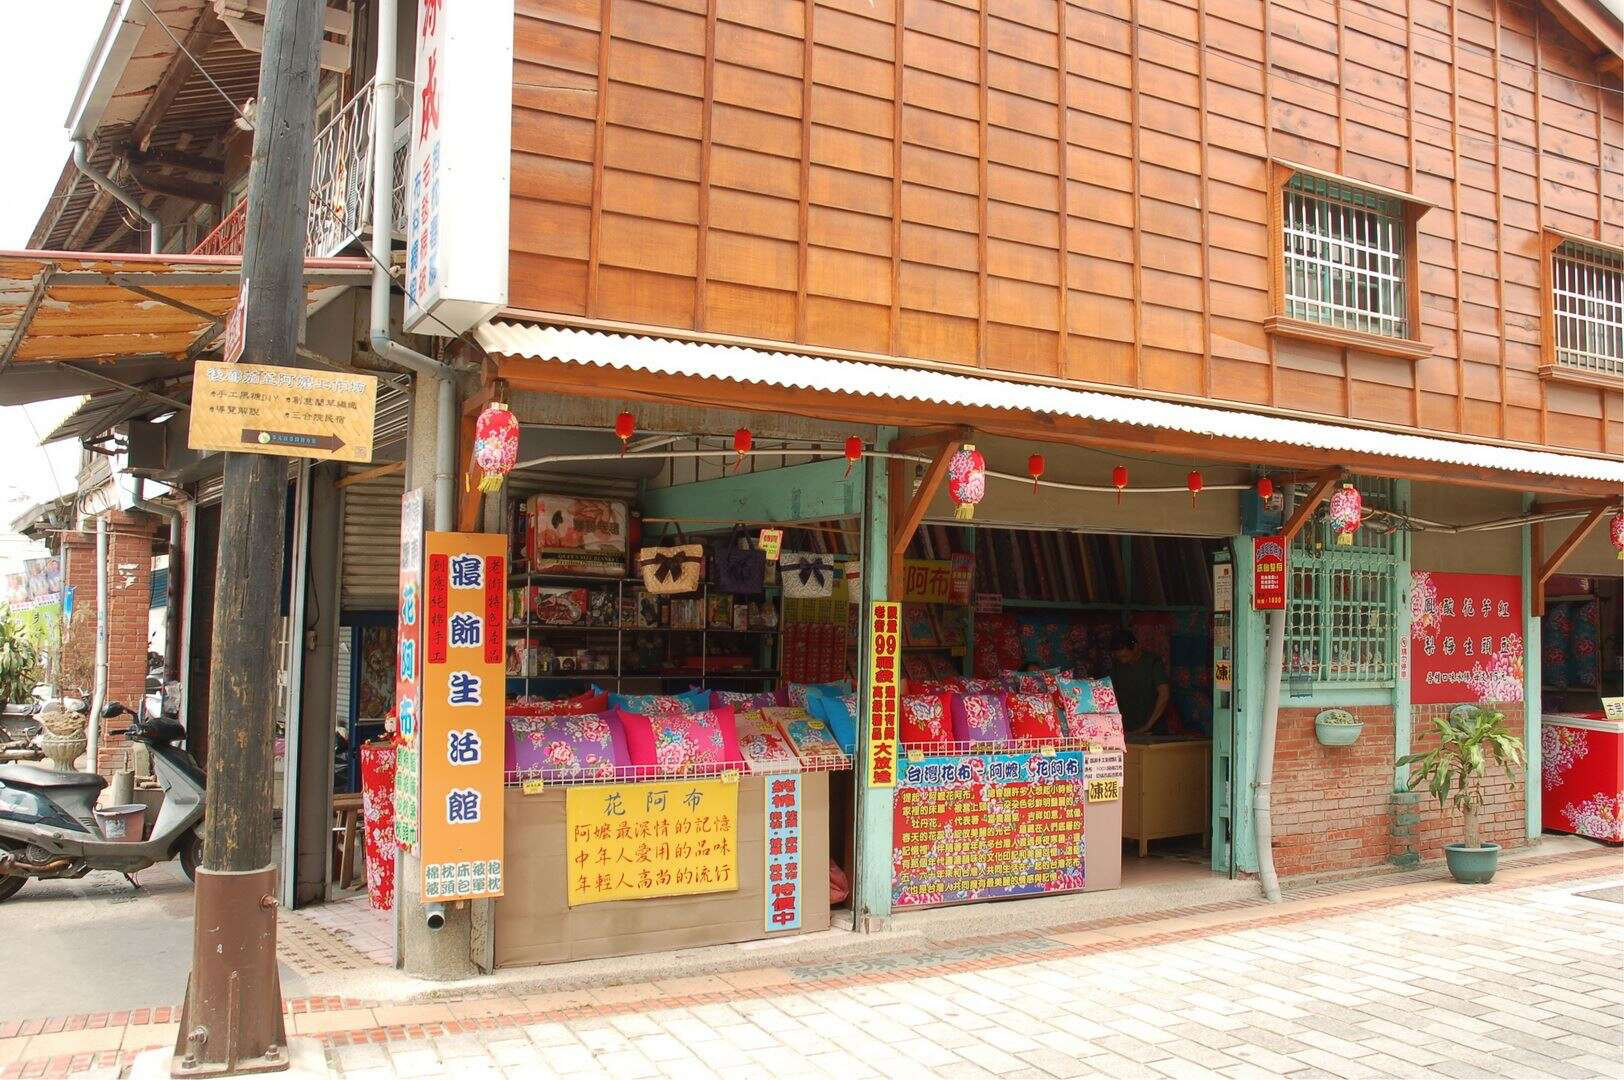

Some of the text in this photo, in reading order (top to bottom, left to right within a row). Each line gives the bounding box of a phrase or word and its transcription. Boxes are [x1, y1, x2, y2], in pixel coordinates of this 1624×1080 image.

[875, 634, 897, 655] 99
[448, 555, 484, 823] 寢飾生活館
[602, 787, 704, 817] 花阿布
[573, 814, 731, 843] 阿嬤最深情的記憶
[574, 838, 731, 868] 中年人愛用的品味
[574, 863, 731, 895] 年輕人高尚的流行
